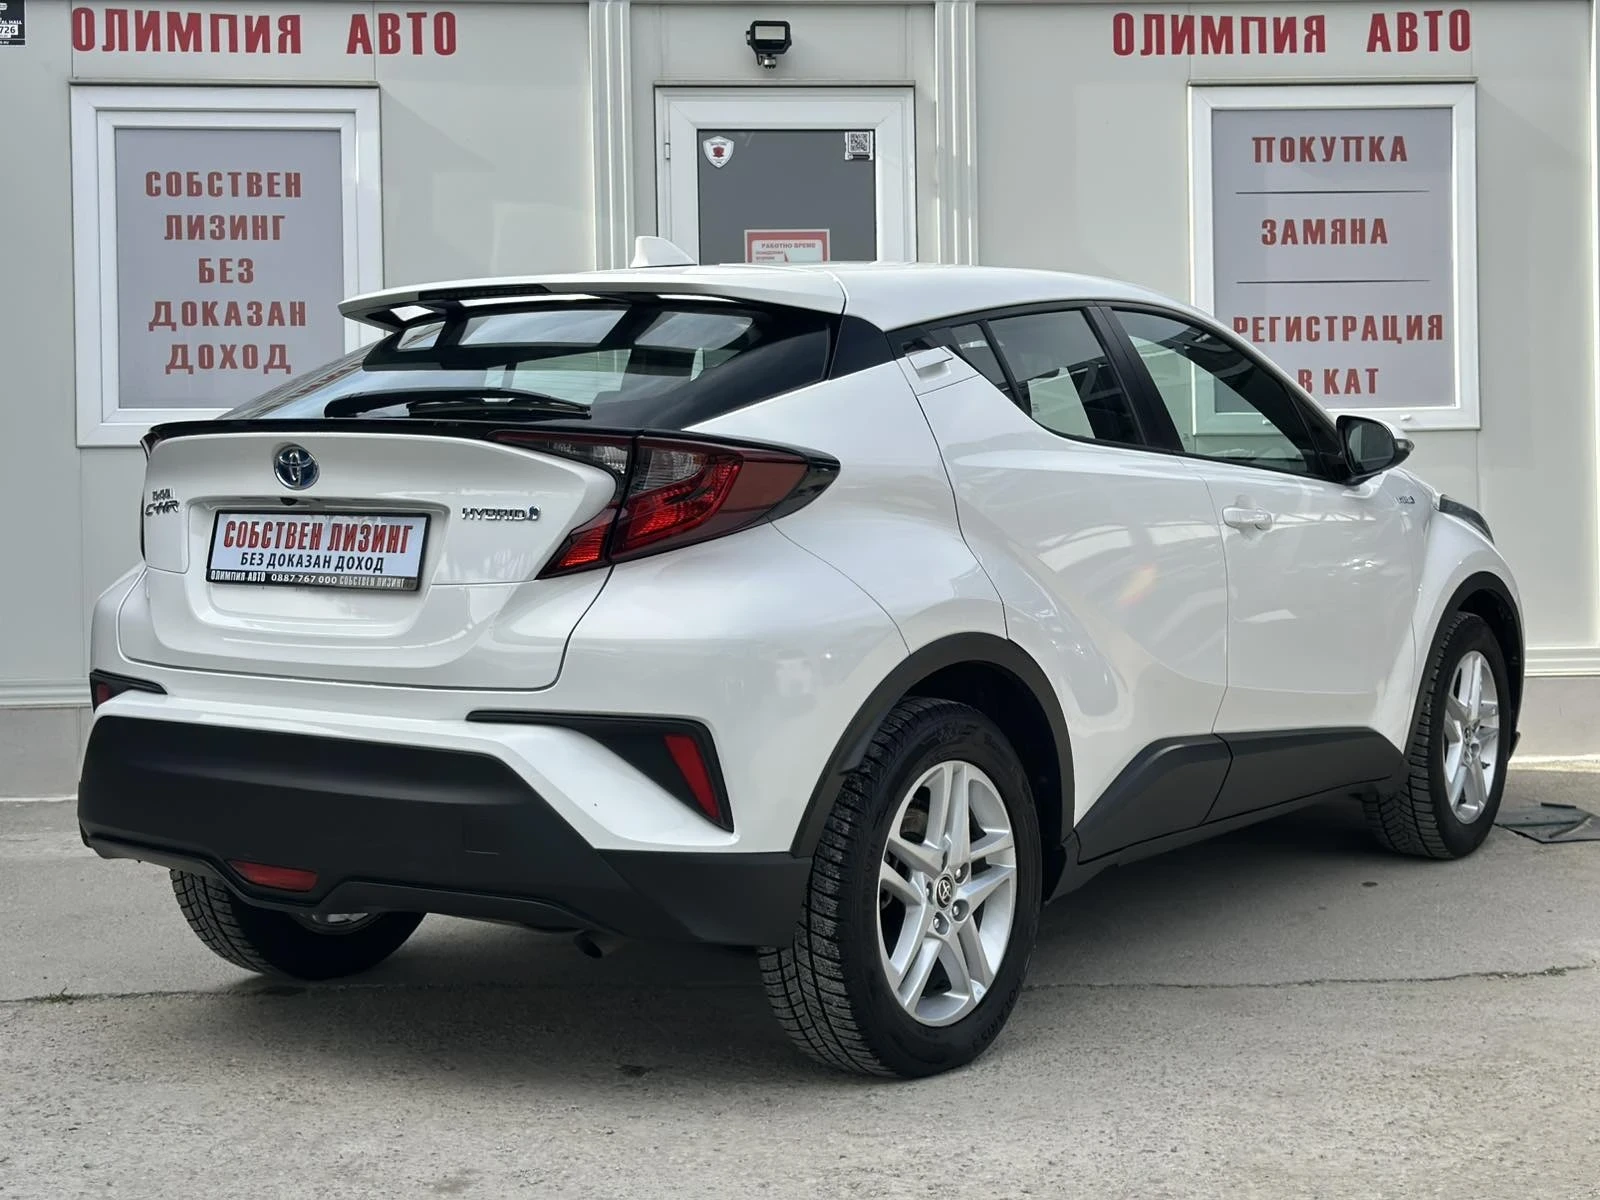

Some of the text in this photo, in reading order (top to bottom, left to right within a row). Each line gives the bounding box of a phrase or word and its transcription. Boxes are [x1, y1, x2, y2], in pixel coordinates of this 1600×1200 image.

[72, 8, 458, 58] ОЛИМПИЯ АВТО
[1112, 9, 1472, 58] ОЛИМПИЯ АВТО
[1252, 135, 1409, 164] ПОКУПКА
[145, 171, 303, 198] СОБСТВЕН
[164, 214, 287, 242] ЛИЗИНГ
[1261, 218, 1389, 247] ЗАМЯНА
[198, 257, 255, 284] БЕЗ
[148, 301, 307, 332] ДОКАЗАН
[1233, 314, 1444, 345] РЕГИСТРАЦИЯ
[165, 343, 292, 375] ДОХОД
[1297, 367, 1379, 395] В КАТ
[462, 507, 526, 521] HYBRID
[223, 520, 413, 554] СОБСТВЕН ЛИЗИНГ
[240, 552, 384, 574] БЕЗ ДОКАЗАН ДОХОД
[210, 570, 405, 588] ОЛИМПИЯ АВТО 0887 767 000 СОБСТВЕН ЛИЗИНГ
